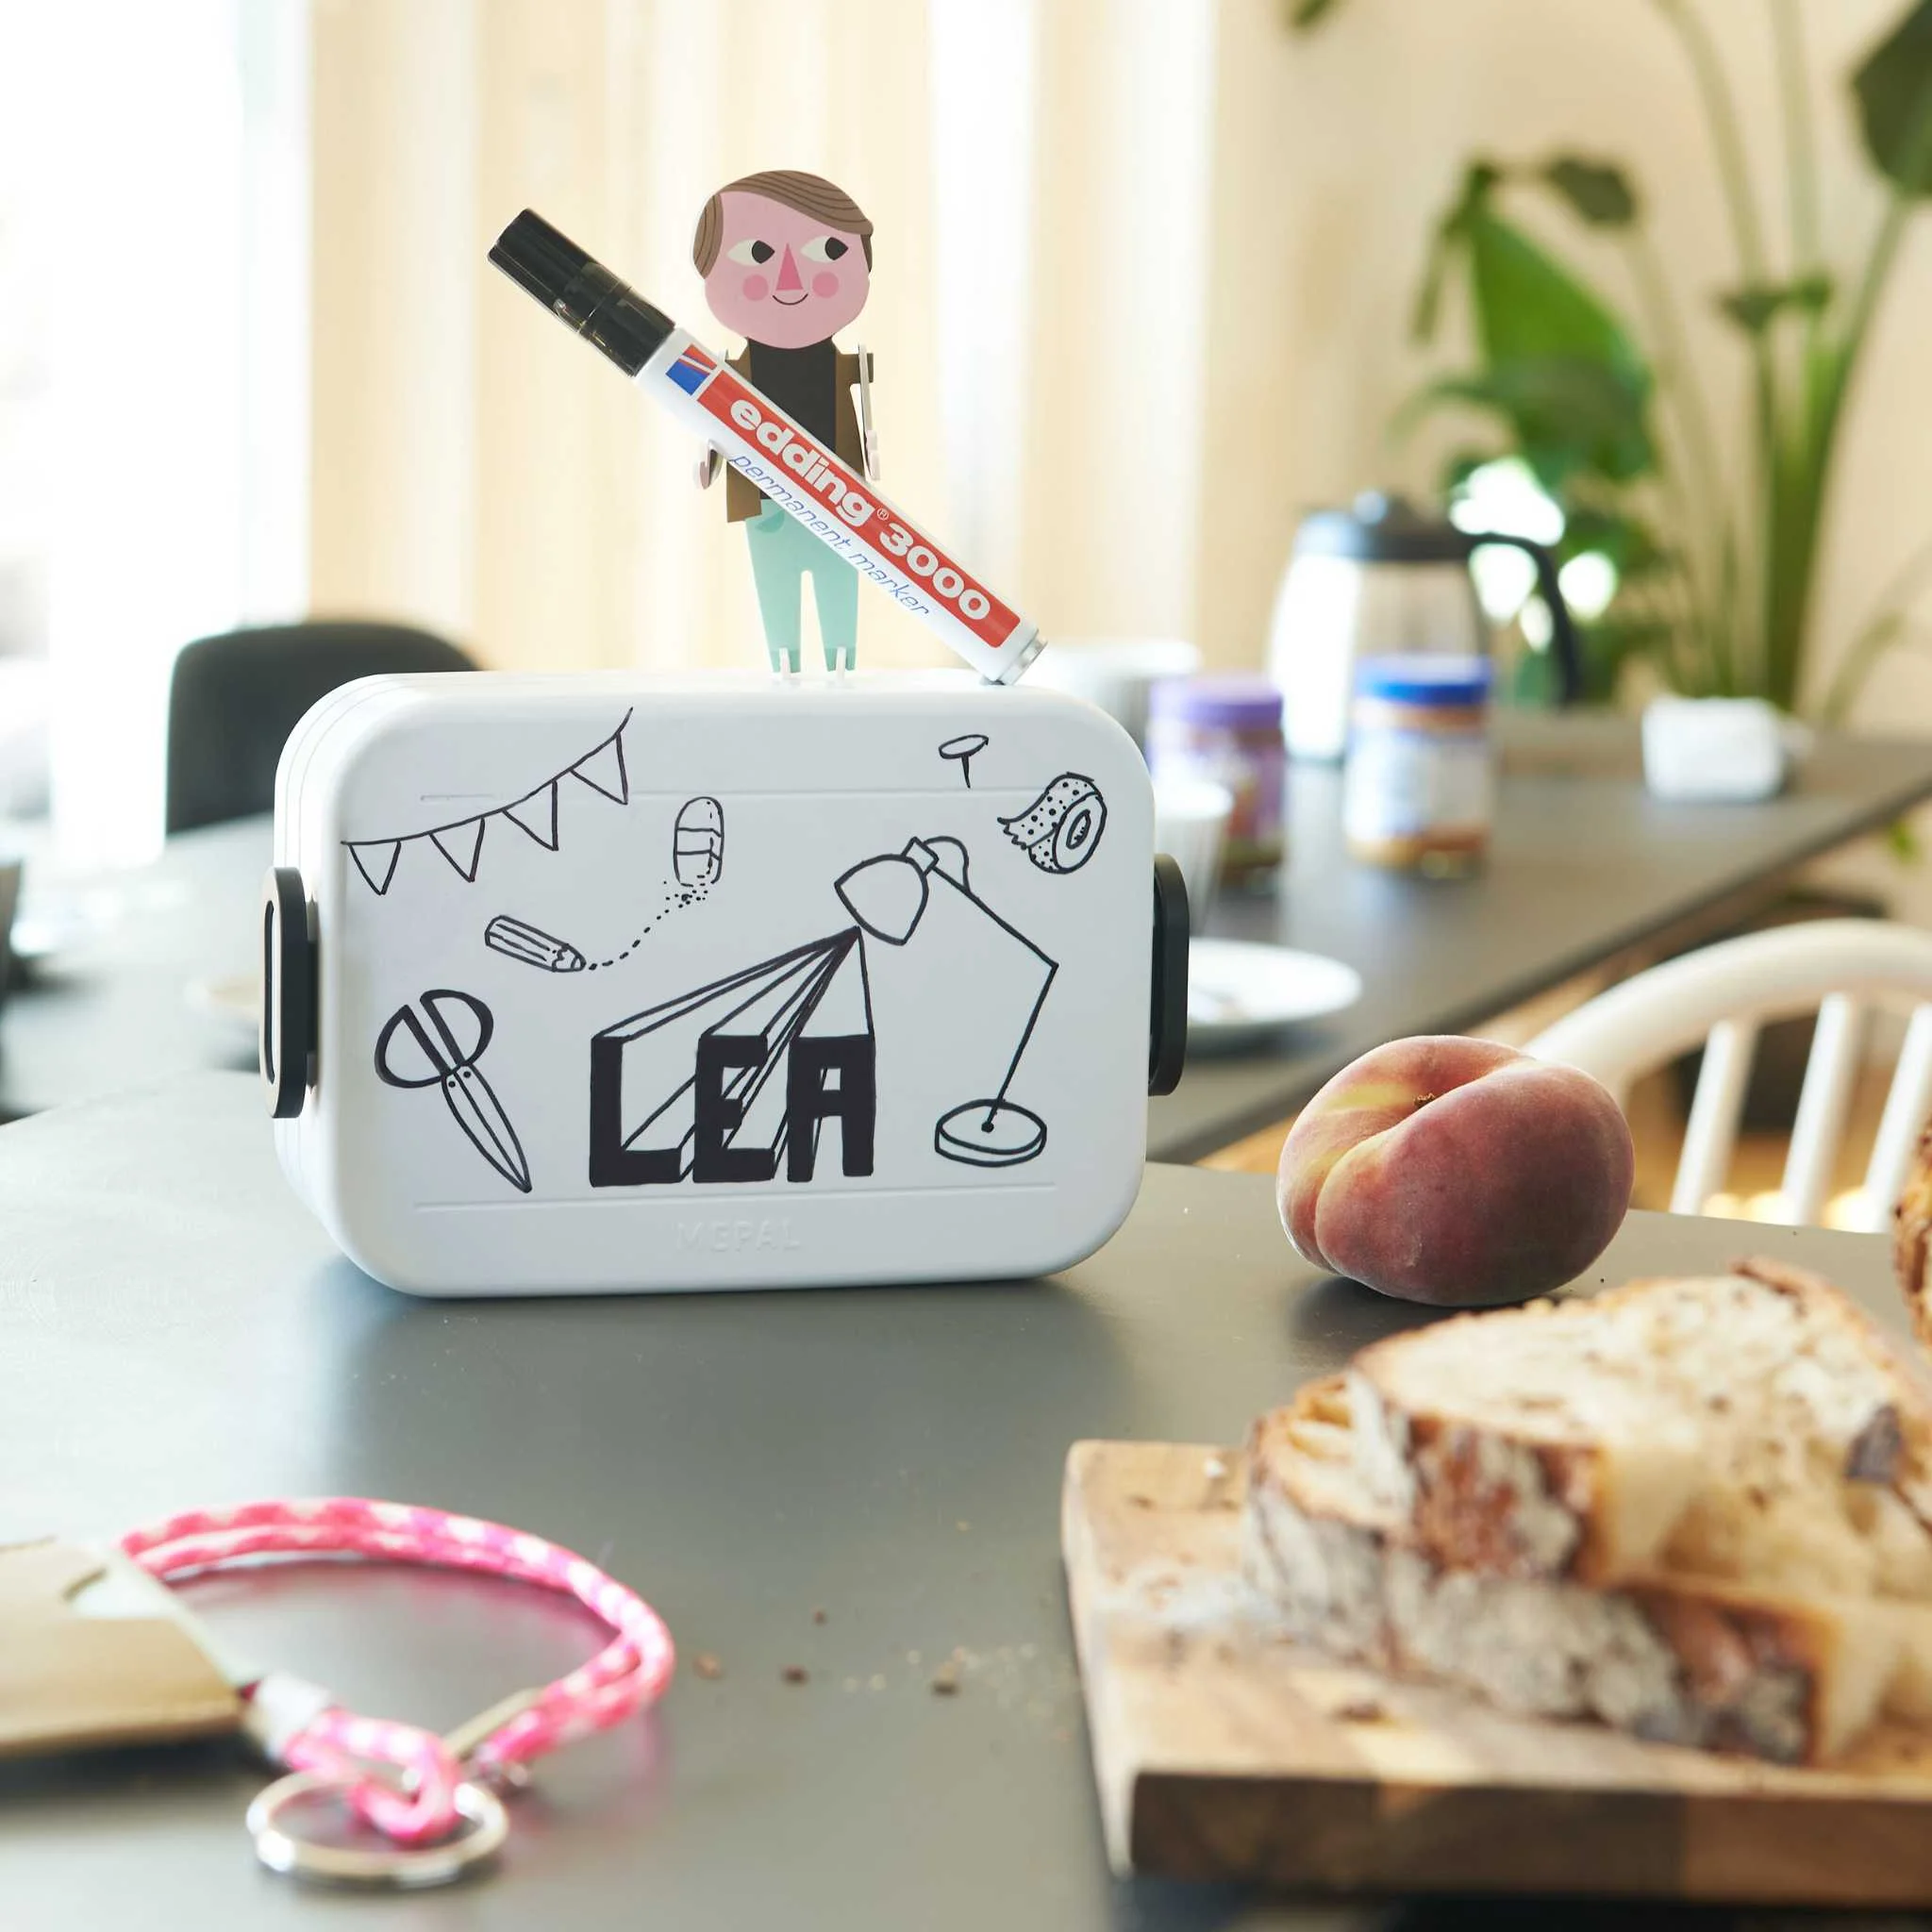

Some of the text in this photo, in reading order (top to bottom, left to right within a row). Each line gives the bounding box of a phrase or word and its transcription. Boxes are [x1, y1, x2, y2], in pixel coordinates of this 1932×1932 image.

[731, 455, 929, 616] permanent marker
[879, 524, 991, 620] 3000
[589, 1035, 876, 1187] LEA
[675, 1216, 801, 1253] MEPAL
